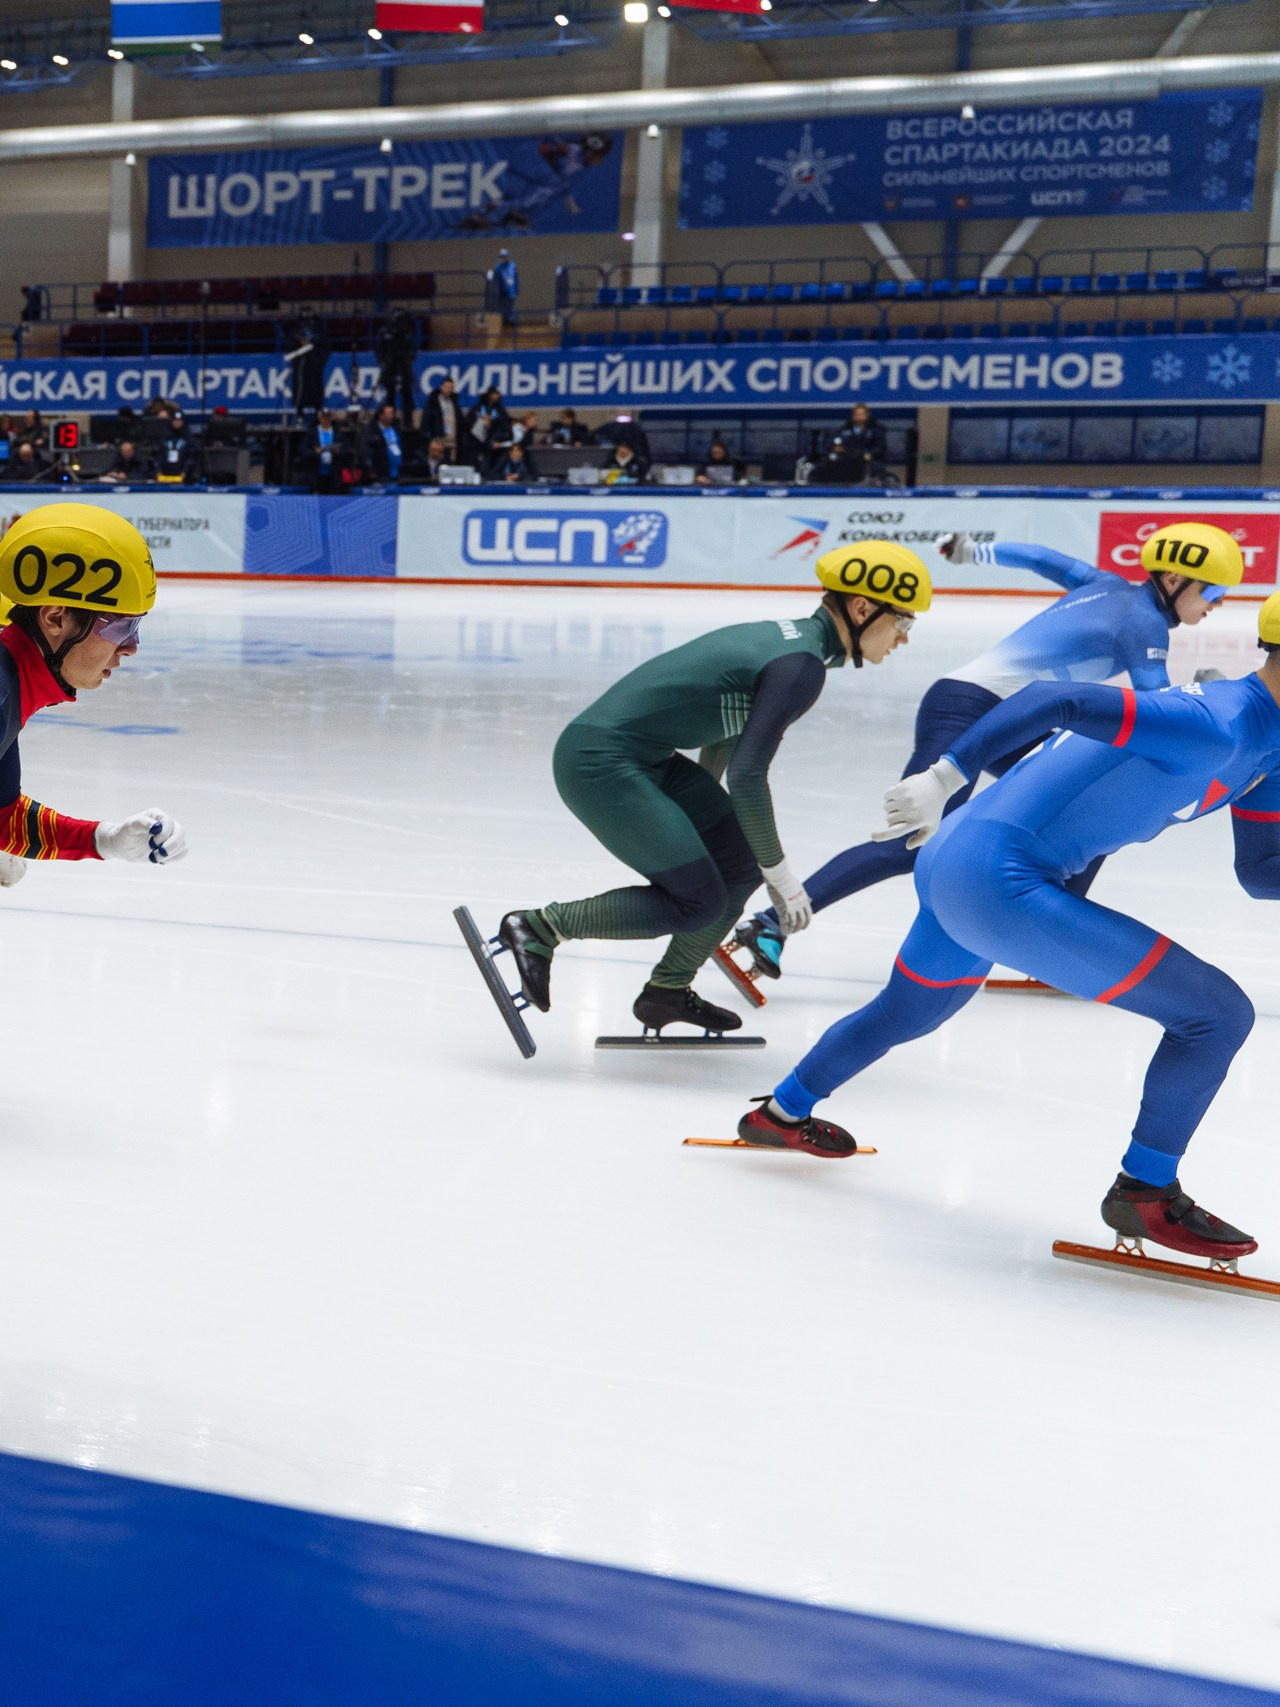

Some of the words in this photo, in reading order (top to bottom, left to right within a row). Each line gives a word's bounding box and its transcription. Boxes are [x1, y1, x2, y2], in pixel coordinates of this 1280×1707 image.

[886, 107, 1134, 140] ВСЕРОССИЙСКАЯ
[883, 137, 1091, 166] СПАРТАКИАДА
[1098, 133, 1171, 157] 2024
[168, 160, 509, 218] ШОРТ-ТРЕК
[422, 354, 736, 397] СИЛЬНЕЙШИХ
[746, 352, 1124, 394] СПОРТСМЕНОВ
[467, 517, 608, 563] ЦСП
[847, 511, 905, 525] СОЮЗ
[13, 544, 123, 607] 022
[1155, 538, 1210, 568] 110
[839, 557, 920, 603] 008
